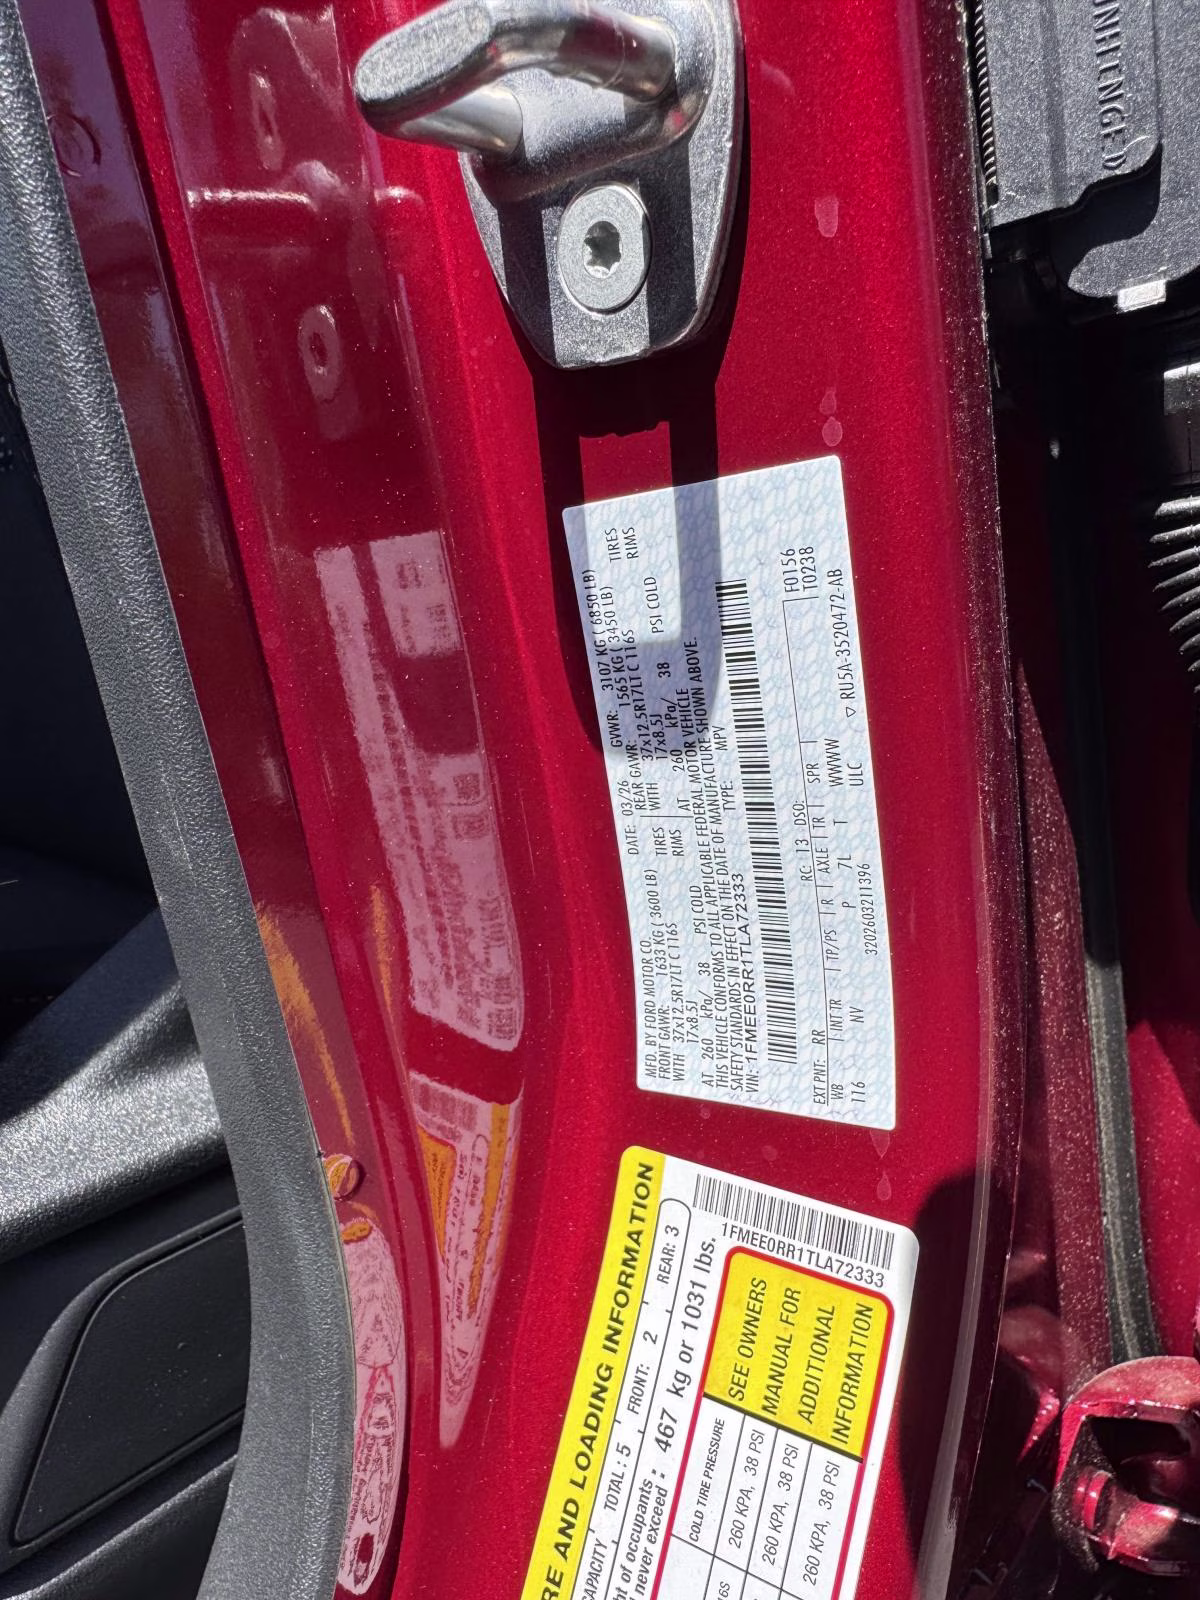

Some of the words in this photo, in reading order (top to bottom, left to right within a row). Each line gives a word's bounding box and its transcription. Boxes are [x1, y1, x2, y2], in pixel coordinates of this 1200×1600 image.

[1093, 0, 1128, 171] NHINGED
[604, 527, 622, 562] TIRES
[622, 526, 639, 559] RIMS
[582, 569, 596, 589] LB)
[780, 548, 800, 593] F0156
[799, 546, 818, 591] T0238
[600, 586, 614, 606] LB)
[643, 576, 660, 609] COLD
[586, 594, 603, 625] 6850
[603, 611, 621, 643] 3450
[649, 615, 664, 634] PSI
[827, 568, 856, 700] RU5A-3520472-AB
[594, 639, 608, 656] KG
[622, 629, 638, 659] 116S
[609, 656, 625, 673] KG
[656, 662, 671, 678] 38
[683, 636, 703, 683] ABOVE.
[598, 661, 614, 691] 3107
[615, 677, 631, 707] 1565
[629, 676, 654, 761] 37x12.5R17LT
[660, 698, 679, 728] kPa/
[676, 688, 694, 737] VEHICLE
[690, 687, 709, 733] SHOWN
[607, 710, 623, 747] GVWR:
[650, 713, 668, 760] 17x8.5J
[712, 725, 728, 751] MPV
[625, 739, 642, 778] GAWR:
[669, 749, 685, 772] 260
[682, 741, 701, 783] MOTOR
[824, 738, 844, 787] WWWW
[698, 737, 721, 825] MANUFACTURE
[805, 763, 821, 784] SPR
[847, 762, 864, 787] ULC
[617, 781, 634, 816] 03/26
[632, 782, 647, 810] REAR
[646, 782, 661, 810] WITH
[677, 797, 691, 812] AT
[720, 780, 737, 811] TYPE:
[690, 787, 709, 837] FEDERAL
[792, 800, 807, 826] DSO:
[812, 817, 826, 830] TR
[625, 825, 639, 855] DATE:
[652, 827, 668, 856] TIRES
[669, 829, 685, 857] RIMS
[710, 828, 725, 844] OF
[795, 839, 810, 853] 13
[697, 841, 719, 907] APPLICABLE
[712, 848, 729, 876] DATE
[800, 865, 813, 881] RC:
[815, 847, 831, 874] AXLE
[837, 854, 852, 869] 7L
[644, 869, 657, 887] LB)
[718, 879, 732, 901] THE
[647, 890, 662, 918] 3600
[689, 886, 704, 913] COLD
[720, 905, 734, 921] ON
[842, 901, 856, 909] P
[857, 863, 878, 956] 3202603211396
[693, 918, 707, 934] PSI
[706, 910, 720, 930] ALL
[640, 937, 652, 954] CO.
[651, 930, 665, 945] KG
[665, 922, 680, 949] 116S
[709, 933, 722, 947] TO
[723, 924, 739, 961] EFFECT
[824, 929, 839, 961] TP/PS
[654, 949, 668, 977] 1633
[698, 962, 711, 976] 38
[727, 966, 741, 978] IN
[731, 873, 758, 1064] 1FMEE0RR1TLA72333
[641, 958, 655, 997] MOTOR
[711, 950, 727, 1012] CONFORMS
[644, 1001, 656, 1029] FORD
[669, 963, 685, 1043] 37x12.5R17LT
[698, 990, 713, 1019] kPa/
[728, 982, 743, 1048] STANDARDS
[830, 999, 842, 1011] TR
[849, 1006, 864, 1023] NV
[657, 1005, 670, 1041] GAWR:
[685, 1000, 699, 1044] 17x8.5J
[830, 1013, 843, 1032] INT
[645, 1032, 657, 1046] BY
[701, 1038, 714, 1060] 260
[714, 1015, 729, 1060] VEHICLE
[812, 1029, 826, 1045] RR
[645, 1051, 657, 1078] MFD.
[658, 1043, 671, 1079] FRONT
[673, 1054, 685, 1082] WITH
[731, 1052, 743, 1091] SAFETY
[813, 1059, 826, 1083] PNT:
[701, 1072, 714, 1087] AT
[716, 1064, 729, 1088] THIS
[745, 1069, 759, 1093] VIN:
[813, 1085, 826, 1105] EXT
[831, 1083, 843, 1100] WB
[850, 1081, 865, 1103] 116
[665, 1224, 679, 1237] 3
[656, 1242, 676, 1284] REAR:
[693, 1237, 716, 1273] lbs.
[721, 1222, 885, 1288] 1FMEE0RR1TLA72333
[681, 1280, 707, 1331] 1031
[738, 1277, 768, 1358] OWNERS
[642, 1330, 658, 1345] 2
[678, 1339, 693, 1363] or
[762, 1333, 793, 1416] MANUAL
[779, 1287, 801, 1327] FOR
[554, 1498, 580, 1562] AND
[569, 1362, 614, 1490] LOADING
[602, 1162, 654, 1354] INFORMATION
[798, 1305, 835, 1424] ADDITIONAL
[830, 1302, 874, 1443] INFORMATION
[628, 1363, 650, 1415] FRONT:
[666, 1369, 692, 1397] kg
[728, 1362, 750, 1401] SEE
[655, 1407, 678, 1453] 467
[749, 1429, 765, 1453] PSI
[616, 1442, 631, 1457] 5
[703, 1418, 725, 1480] PRESSURE
[783, 1443, 799, 1468] PSI
[744, 1456, 759, 1476] 38
[823, 1460, 840, 1486] PSI
[697, 1480, 711, 1506] TIRE
[778, 1471, 793, 1491] 38
[735, 1486, 755, 1517] KPA,
[819, 1489, 835, 1510] 38
[624, 1478, 653, 1562] occupants
[688, 1510, 704, 1542] COLD
[768, 1501, 789, 1533] KPA,
[635, 1546, 654, 1596] never
[646, 1485, 668, 1544] exceed
[728, 1519, 745, 1549] 260
[809, 1520, 830, 1553] KPA,
[762, 1535, 779, 1565] 260
[620, 1564, 632, 1583] of
[803, 1555, 820, 1585] 260
